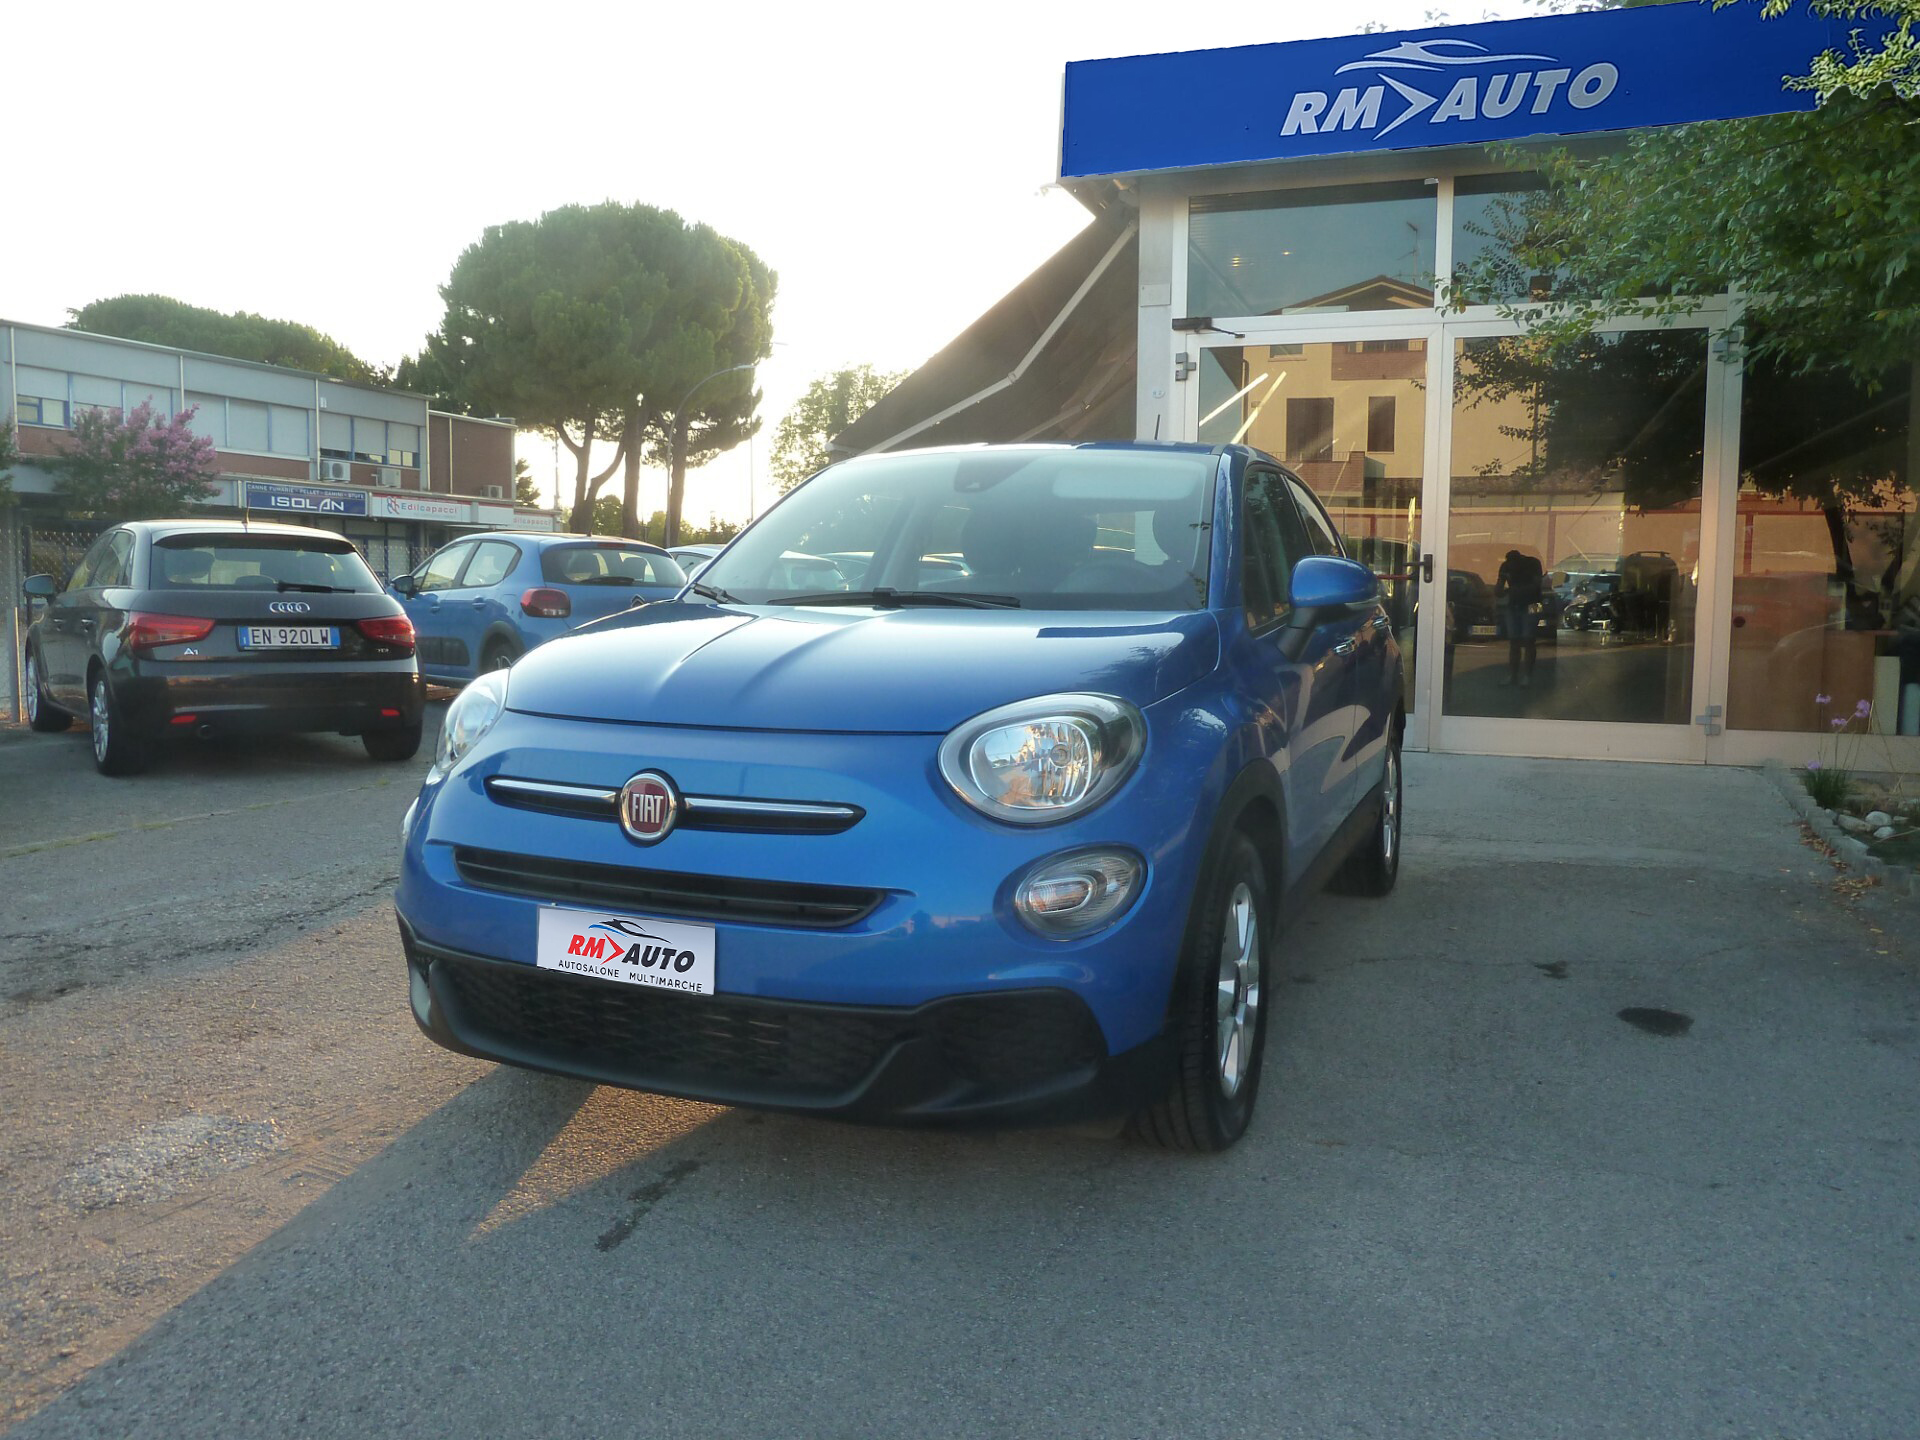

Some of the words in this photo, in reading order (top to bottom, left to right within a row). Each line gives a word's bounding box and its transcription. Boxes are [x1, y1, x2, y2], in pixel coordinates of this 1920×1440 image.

[1280, 85, 1384, 136] RM
[1430, 62, 1619, 123] AUTO
[271, 495, 345, 512] ISOLAN
[401, 502, 458, 514] Edilcapacci
[251, 628, 272, 645] EN
[278, 628, 329, 645] 920LW
[183, 647, 199, 655] A1
[631, 793, 664, 824] FIAT
[567, 934, 606, 960] RM
[621, 942, 695, 974] AUTO
[558, 959, 620, 978] AUTOSALONE
[629, 972, 702, 993] MULTIMARCHE
